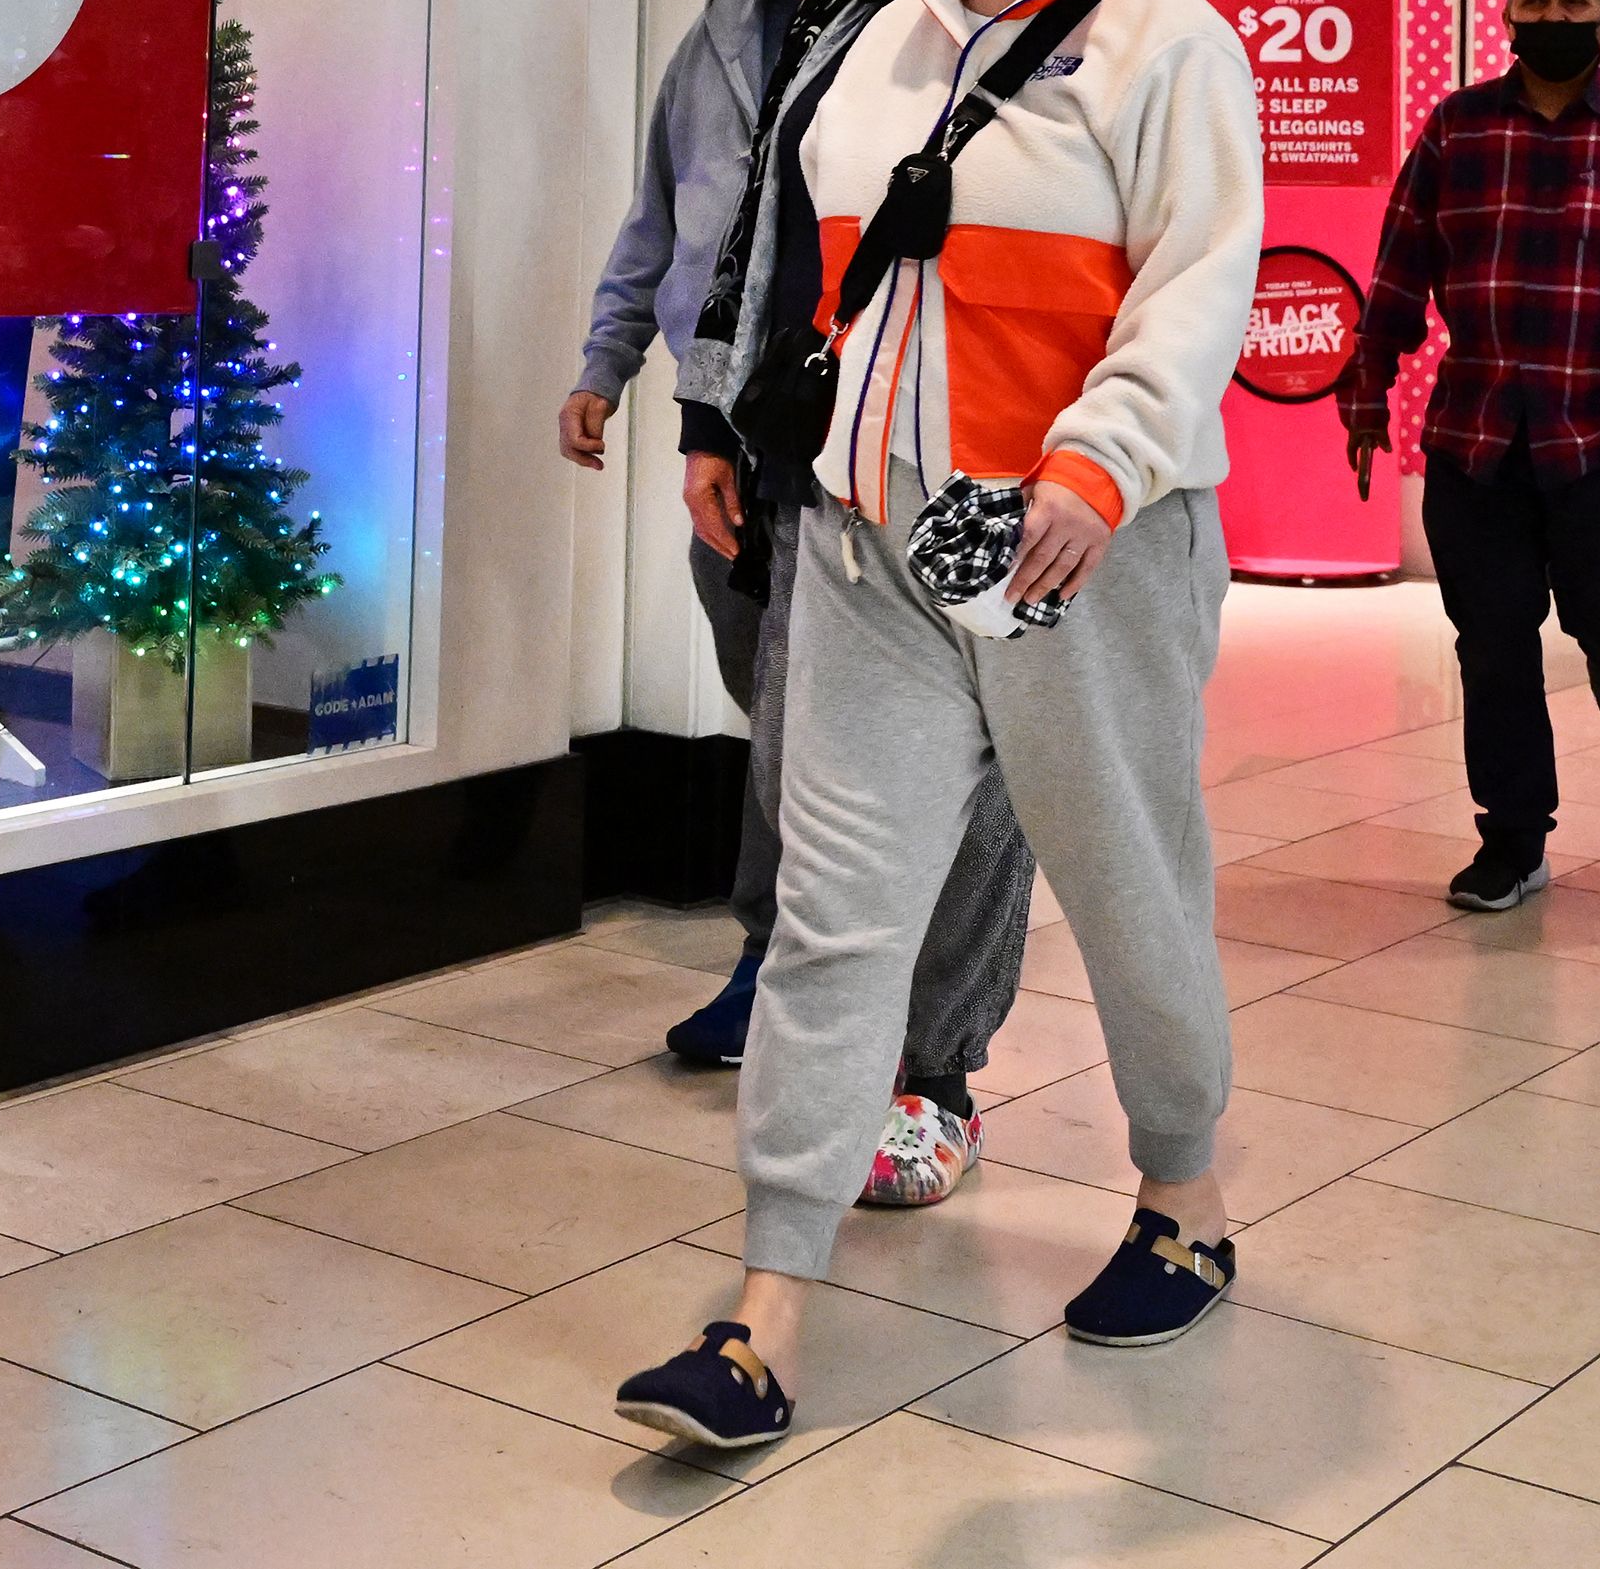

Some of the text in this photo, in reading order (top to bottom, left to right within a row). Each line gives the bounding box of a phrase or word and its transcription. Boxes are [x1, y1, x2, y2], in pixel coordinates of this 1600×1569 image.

[1238, 5, 1353, 64] $20
[1270, 77, 1305, 92] ALL
[1309, 77, 1359, 93] BRAS
[1269, 98, 1328, 114] SLEEP
[1269, 119, 1365, 136] LEGGINGS
[1269, 141, 1352, 152] SWEATSHIRTS
[1269, 152, 1360, 164] & SWEATPANTS
[1249, 302, 1342, 330] BLACK
[1242, 328, 1346, 358] FRIDAY
[315, 691, 395, 717] CODE ADAM
